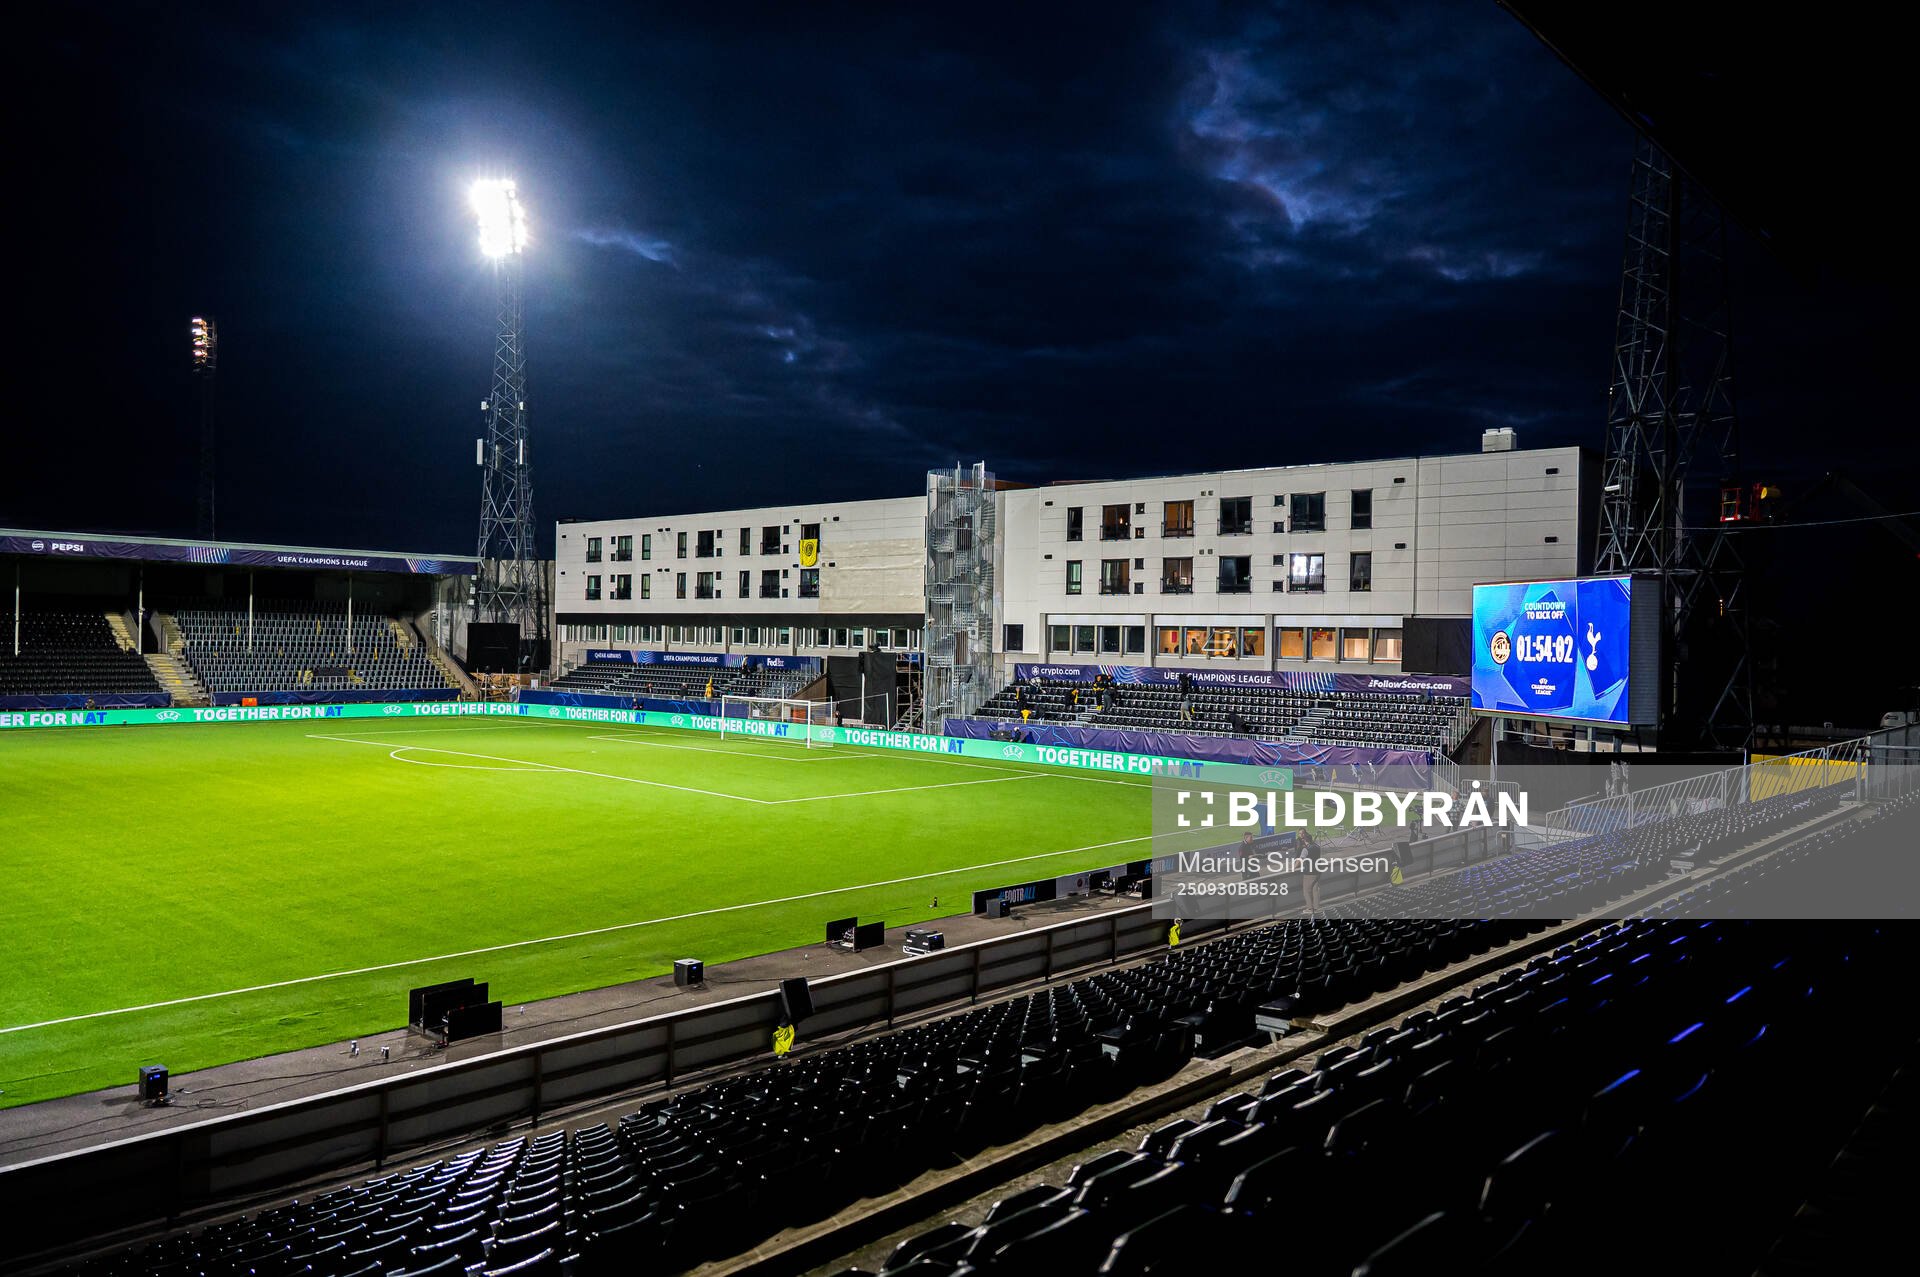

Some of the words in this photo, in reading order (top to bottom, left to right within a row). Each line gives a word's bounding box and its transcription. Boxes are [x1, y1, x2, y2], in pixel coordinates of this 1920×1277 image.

[52, 542, 84, 552] PEPSI
[299, 557, 340, 566] CHAMPIONS
[342, 559, 368, 567] LEAGUE
[1524, 602, 1566, 610] COUNTDOWN
[1526, 611, 1535, 620] TO
[1536, 611, 1551, 620] KICK
[1551, 611, 1565, 620] OFF
[1516, 635, 1574, 663] 01:54:02
[1040, 667, 1080, 677] crypto.com
[1164, 672, 1184, 681] UEF
[1238, 675, 1272, 684] LEAGUE
[194, 706, 277, 720] TOGETHER
[282, 706, 311, 718] FOR
[315, 706, 344, 717] NAT
[413, 704, 486, 715] TOGETHER
[490, 704, 513, 714] FOR
[513, 704, 529, 715] NAT
[565, 708, 609, 721] TOGETHER
[610, 711, 628, 722] FOR
[629, 712, 646, 723] NAT
[29, 713, 68, 726] FOR
[72, 712, 107, 725] NAT
[690, 716, 743, 733] TOGETHER
[745, 722, 766, 735] FOR
[767, 724, 789, 737] NAT
[845, 729, 912, 749] TOGETHER
[913, 738, 937, 751] FOR
[939, 739, 965, 754] NAT
[1002, 744, 1025, 759] UEFA
[1036, 747, 1125, 770] TOGETHER
[1127, 755, 1164, 774] FOR
[1166, 758, 1204, 778] NAT
[1258, 770, 1288, 786] UEFA
